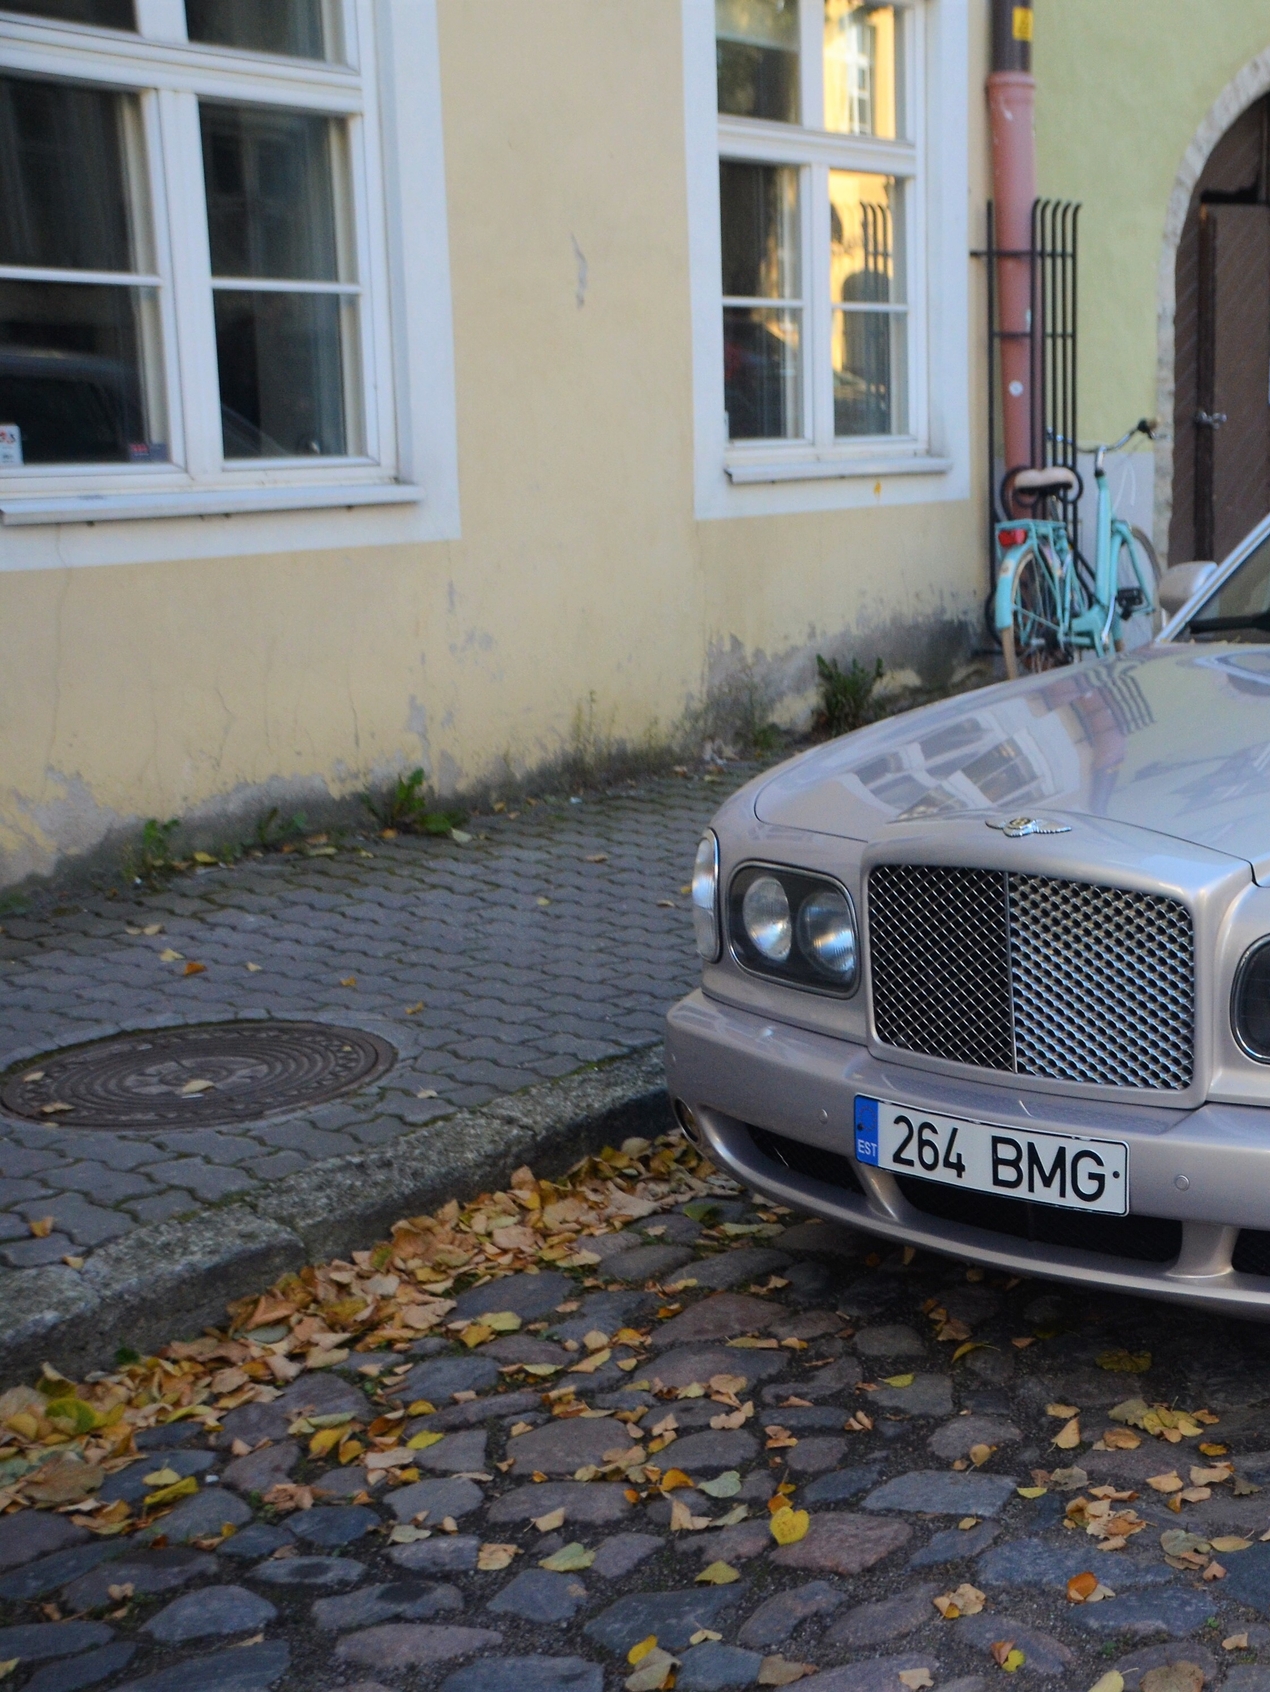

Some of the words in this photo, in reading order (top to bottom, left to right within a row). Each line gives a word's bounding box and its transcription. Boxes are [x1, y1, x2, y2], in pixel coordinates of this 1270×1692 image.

[858, 1139, 878, 1157] EST
[892, 1115, 966, 1179] 264
[991, 1135, 1106, 1202] BMG
